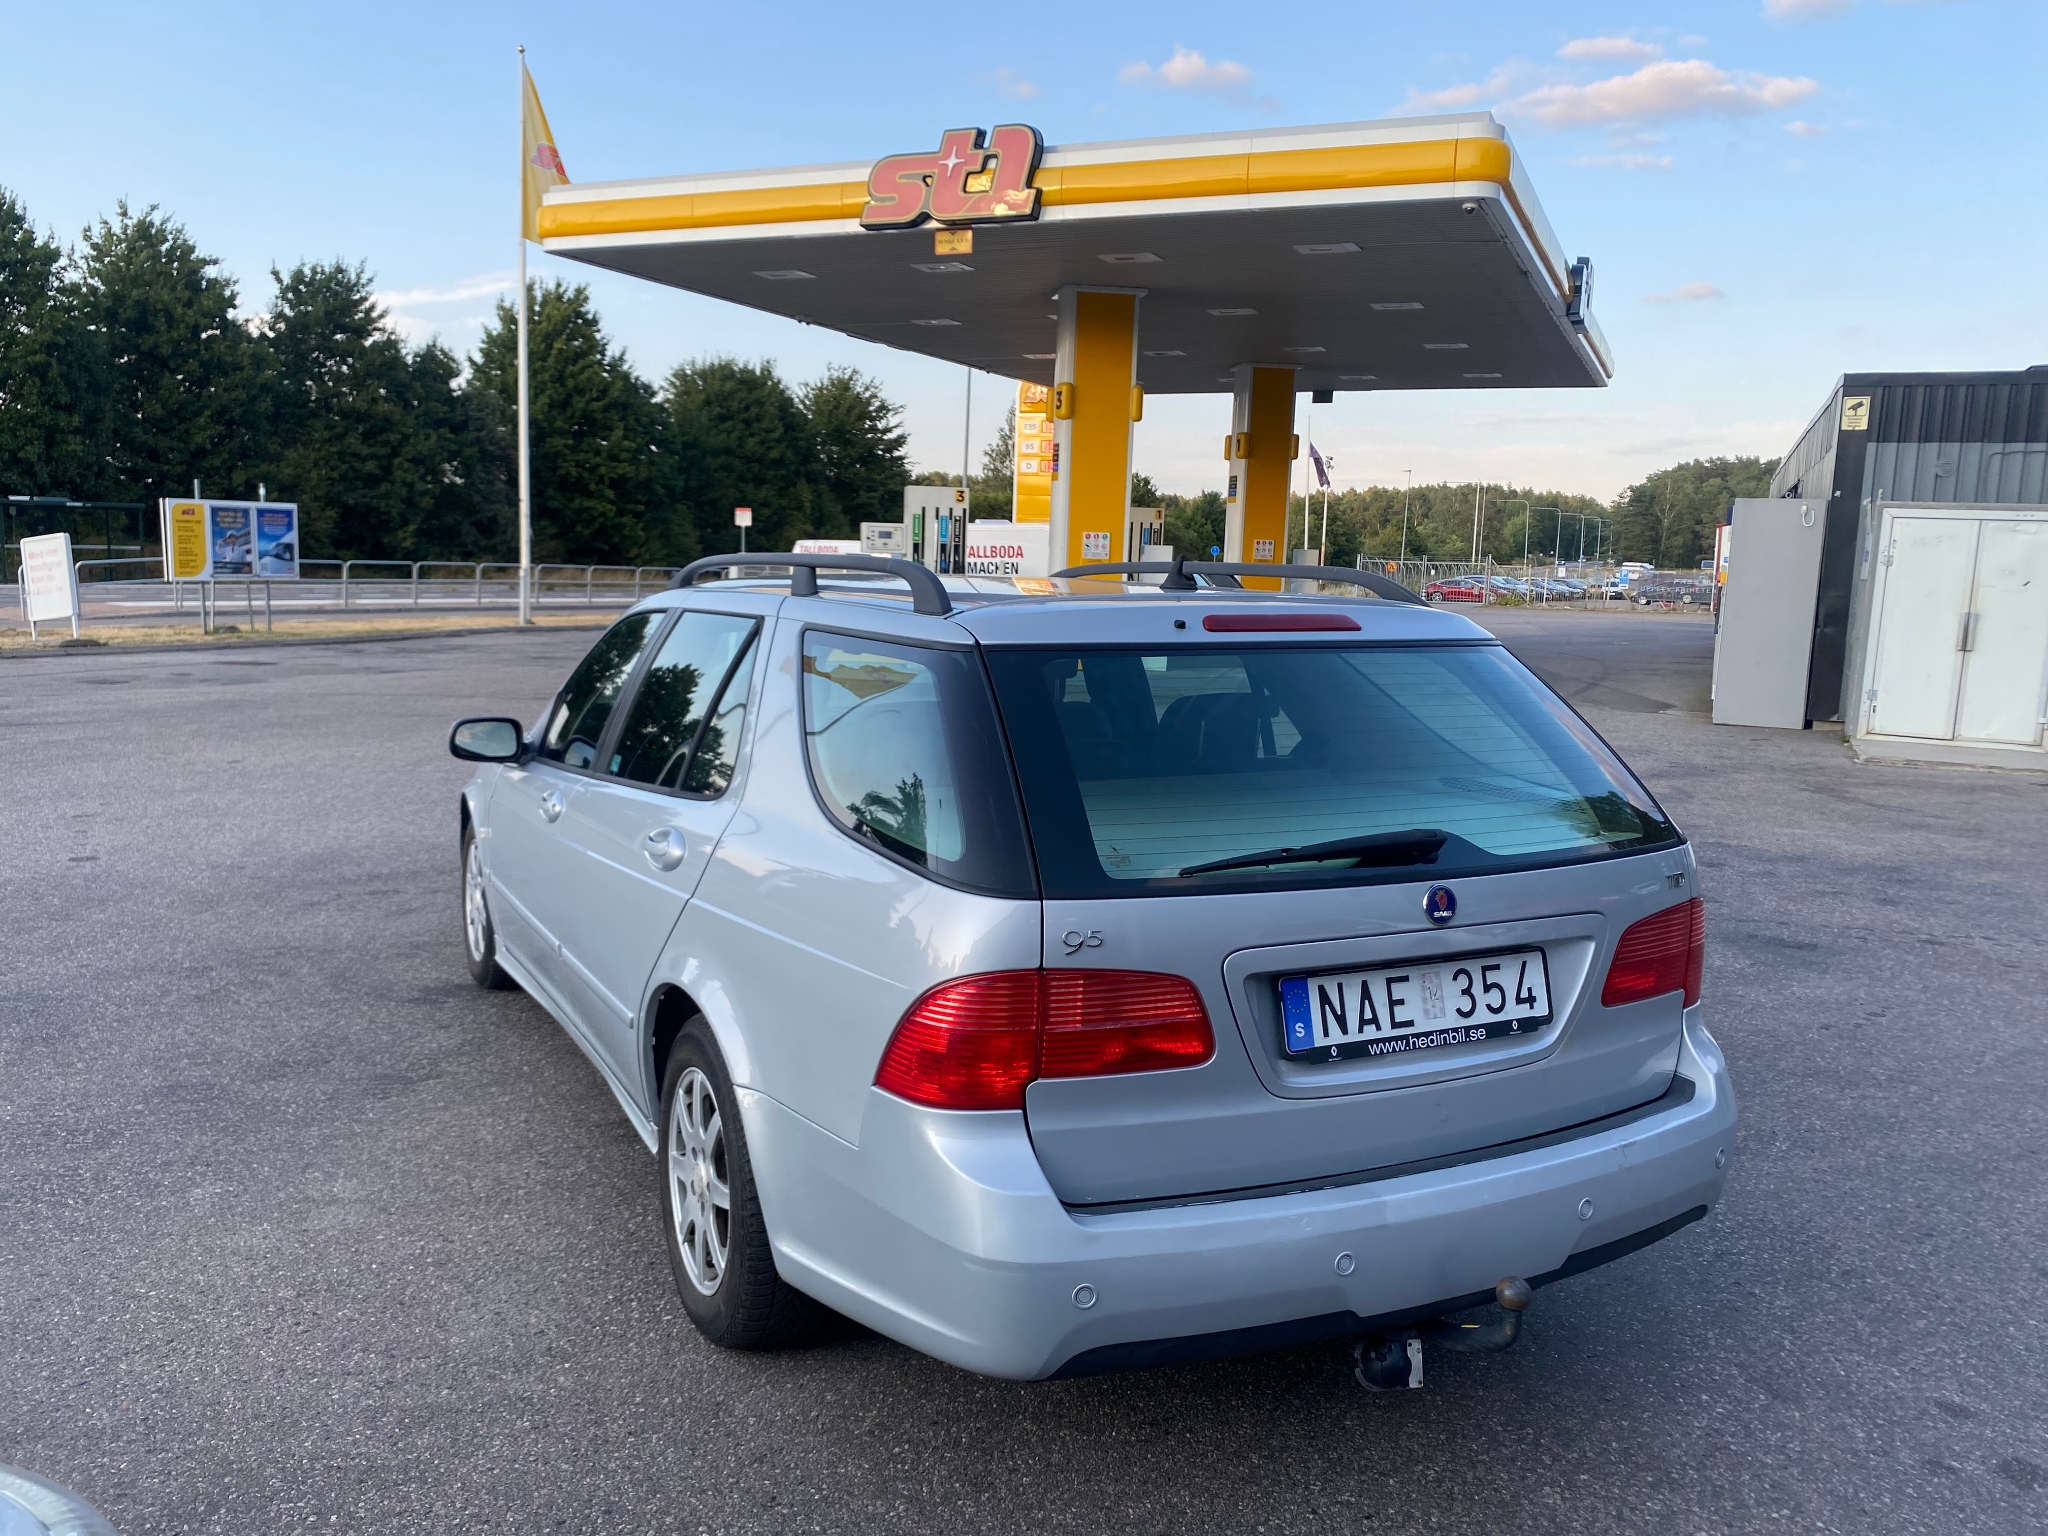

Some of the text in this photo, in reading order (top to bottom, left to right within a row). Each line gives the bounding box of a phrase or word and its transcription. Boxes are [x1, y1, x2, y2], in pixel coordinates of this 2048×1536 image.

[1056, 390, 1063, 410] 3
[956, 490, 965, 502] 3
[800, 546, 839, 554] TALLBODA
[967, 545, 1025, 559] ALLBODA
[1317, 960, 1537, 1038] NAE 354
[1295, 1022, 1305, 1038] S
[1367, 1027, 1487, 1056] www.hedinbil.se
